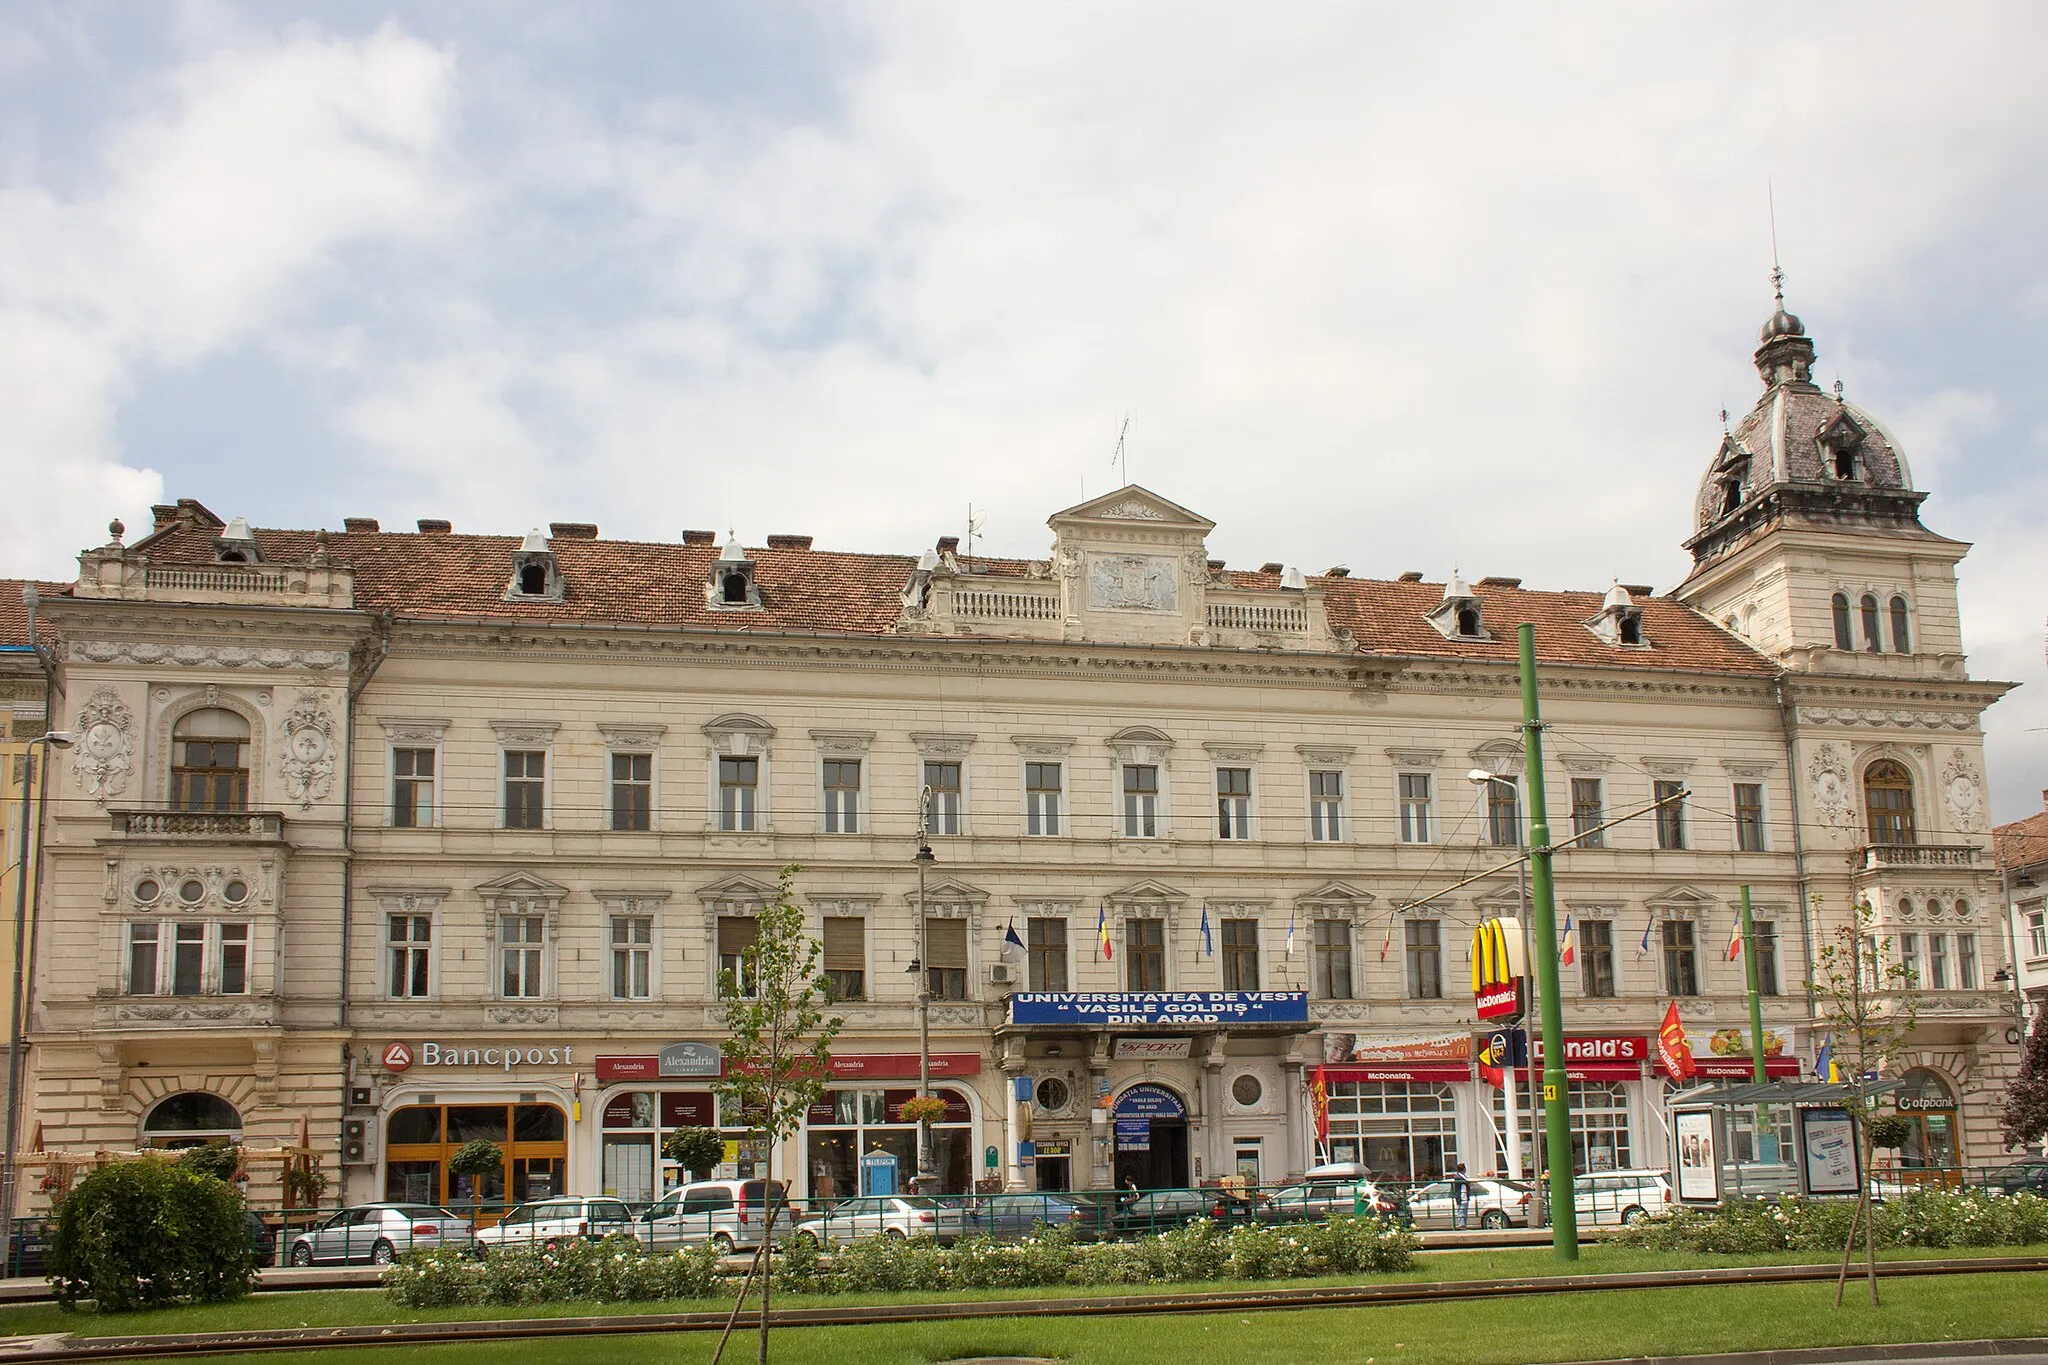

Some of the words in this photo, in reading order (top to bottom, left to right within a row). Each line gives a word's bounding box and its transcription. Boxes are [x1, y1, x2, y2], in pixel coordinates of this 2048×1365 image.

[1017, 993, 1202, 1002] UNIVERSITATEA
[1209, 993, 1238, 1002] DE
[1245, 992, 1303, 1002] VEST
[1477, 990, 1516, 1009] McDonald's
[1075, 1004, 1157, 1013] VASILE
[1107, 1015, 1148, 1024] DIN
[1156, 1014, 1219, 1023] ARAD
[1119, 1042, 1189, 1052] SPORT
[422, 1042, 573, 1072] Bancpost
[664, 1055, 714, 1066] Alexandria
[833, 1060, 864, 1069] Alexandria
[1912, 1096, 1954, 1111] otpbank
